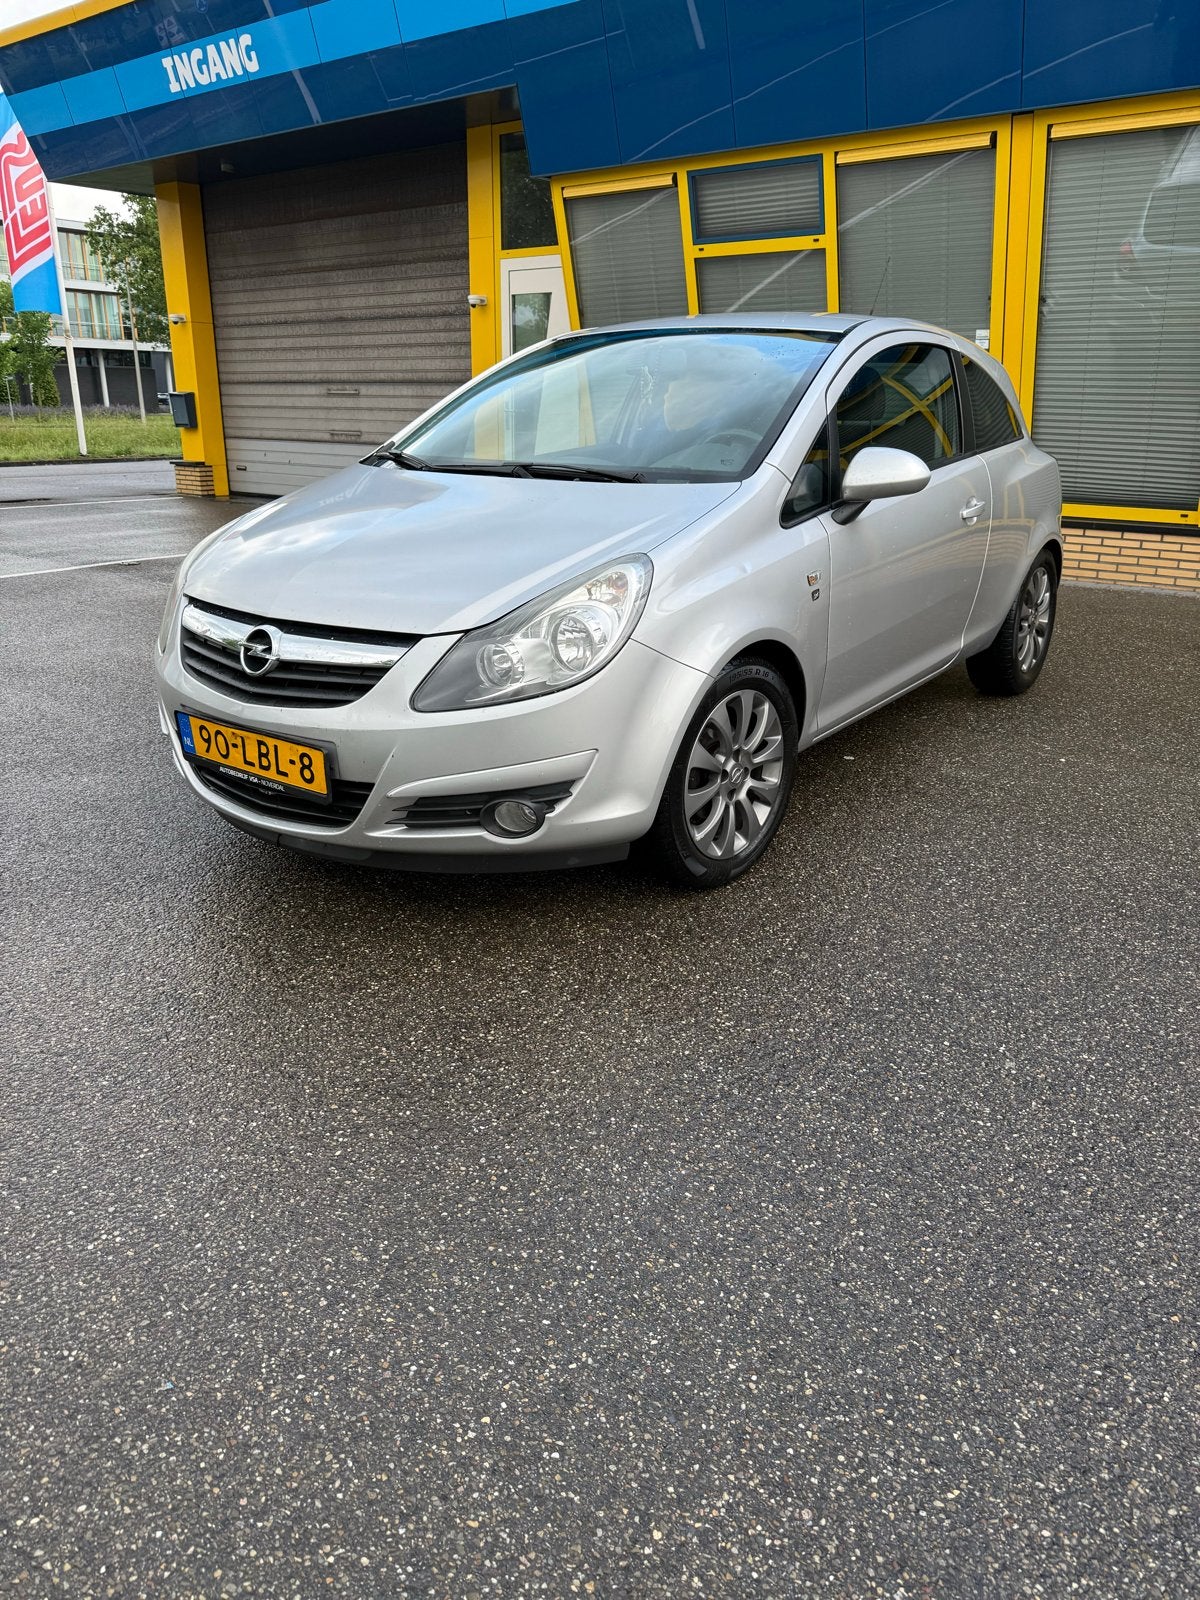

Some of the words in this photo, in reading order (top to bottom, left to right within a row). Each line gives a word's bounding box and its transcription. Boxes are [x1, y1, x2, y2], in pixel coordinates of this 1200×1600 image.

[161, 33, 260, 93] INGANG
[184, 737, 194, 748] NL
[198, 724, 315, 785] 90-LBL-8
